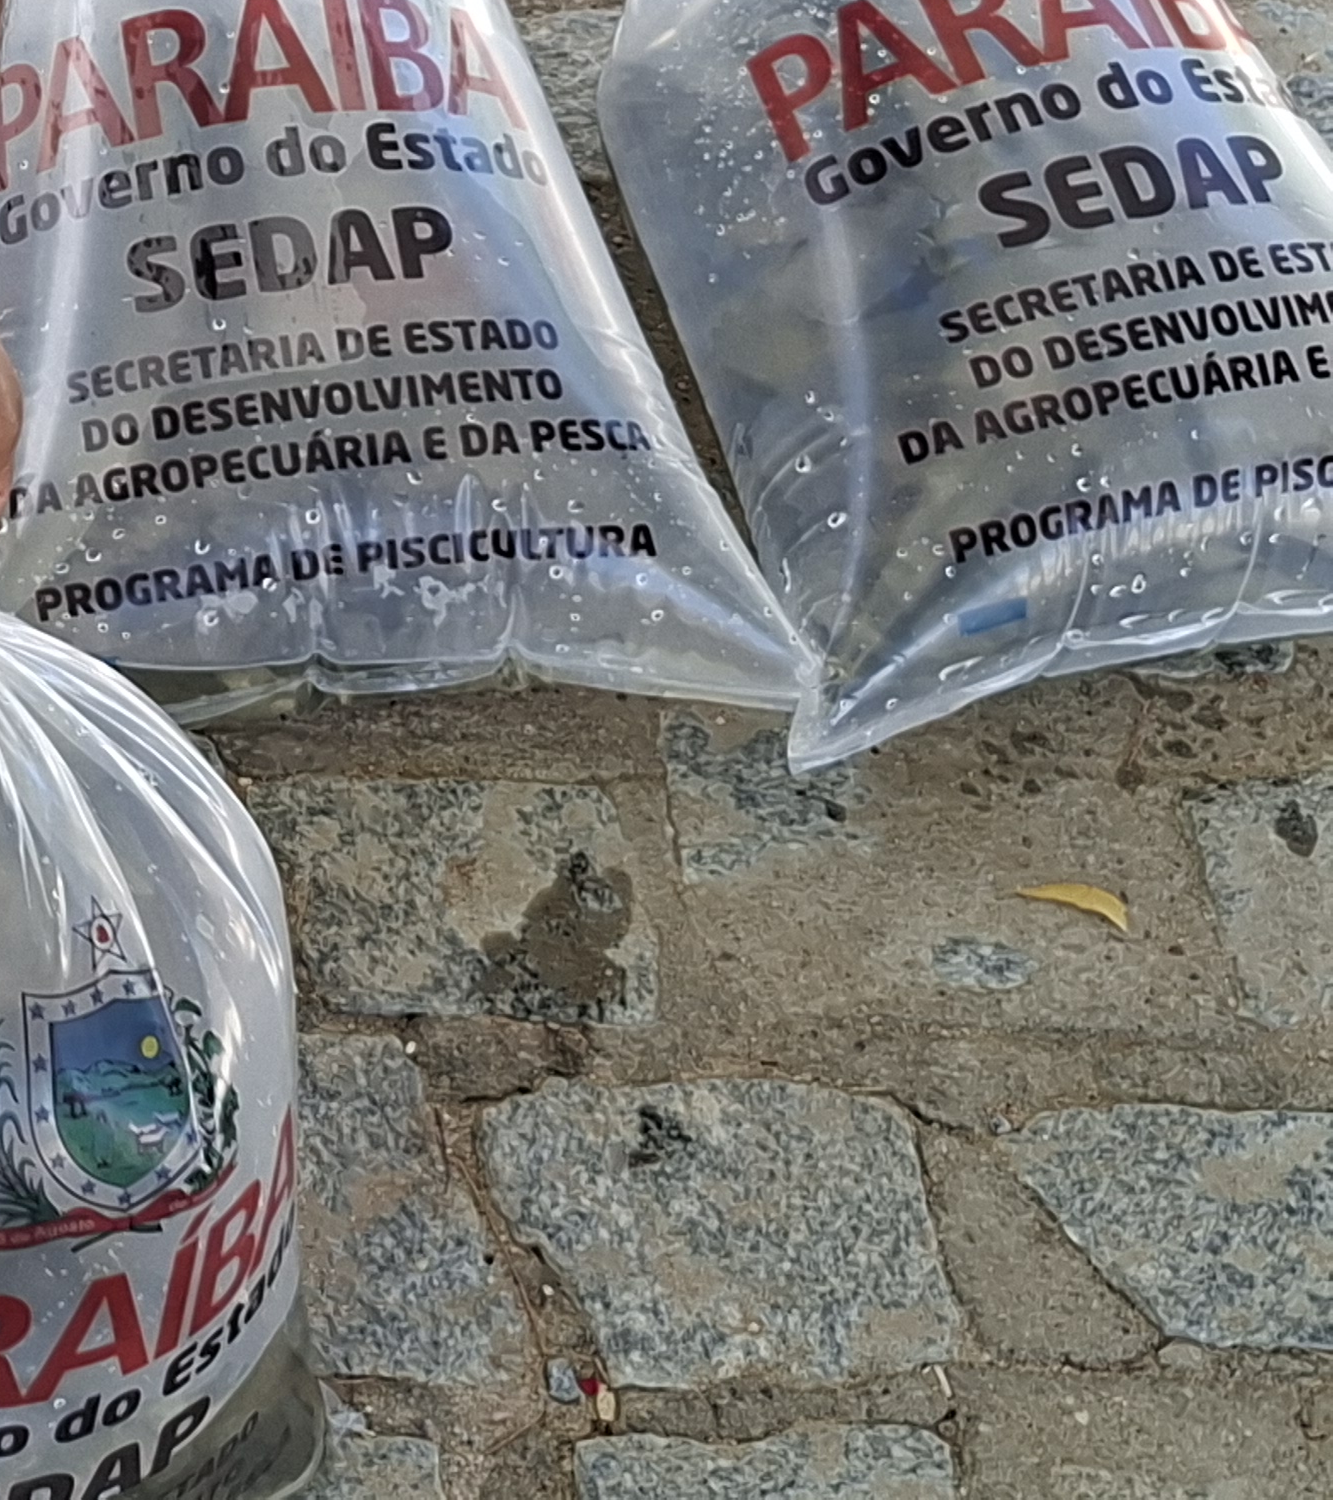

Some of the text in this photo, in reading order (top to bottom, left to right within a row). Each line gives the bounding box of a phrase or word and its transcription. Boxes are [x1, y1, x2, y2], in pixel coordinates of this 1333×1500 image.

[266, 126, 346, 177] do
[367, 122, 549, 186] Estado
[804, 80, 1081, 207] Governo
[1097, 62, 1173, 110] do
[978, 134, 1283, 249] SEDAP
[127, 206, 455, 313] SEDAP
[939, 241, 1333, 344] SECRETARIA DE EST
[67, 318, 559, 405] SECRETARIA DE ESTADO
[969, 291, 1333, 388] DO DESENVOLVIM
[81, 368, 563, 454] DO DESENVOLVIMENTO
[897, 345, 1332, 465] DA AGROPECUÁRIA E
[75, 429, 412, 507] AGROPECUÁRIA
[424, 427, 447, 461] E
[459, 419, 520, 458] DA
[532, 419, 652, 453] PESCA
[949, 480, 1182, 564] PROGRAMA
[1193, 468, 1241, 509] DE
[34, 522, 658, 622] PROGRAMA DE PISCICULTURA
[54, 1388, 140, 1446] do
